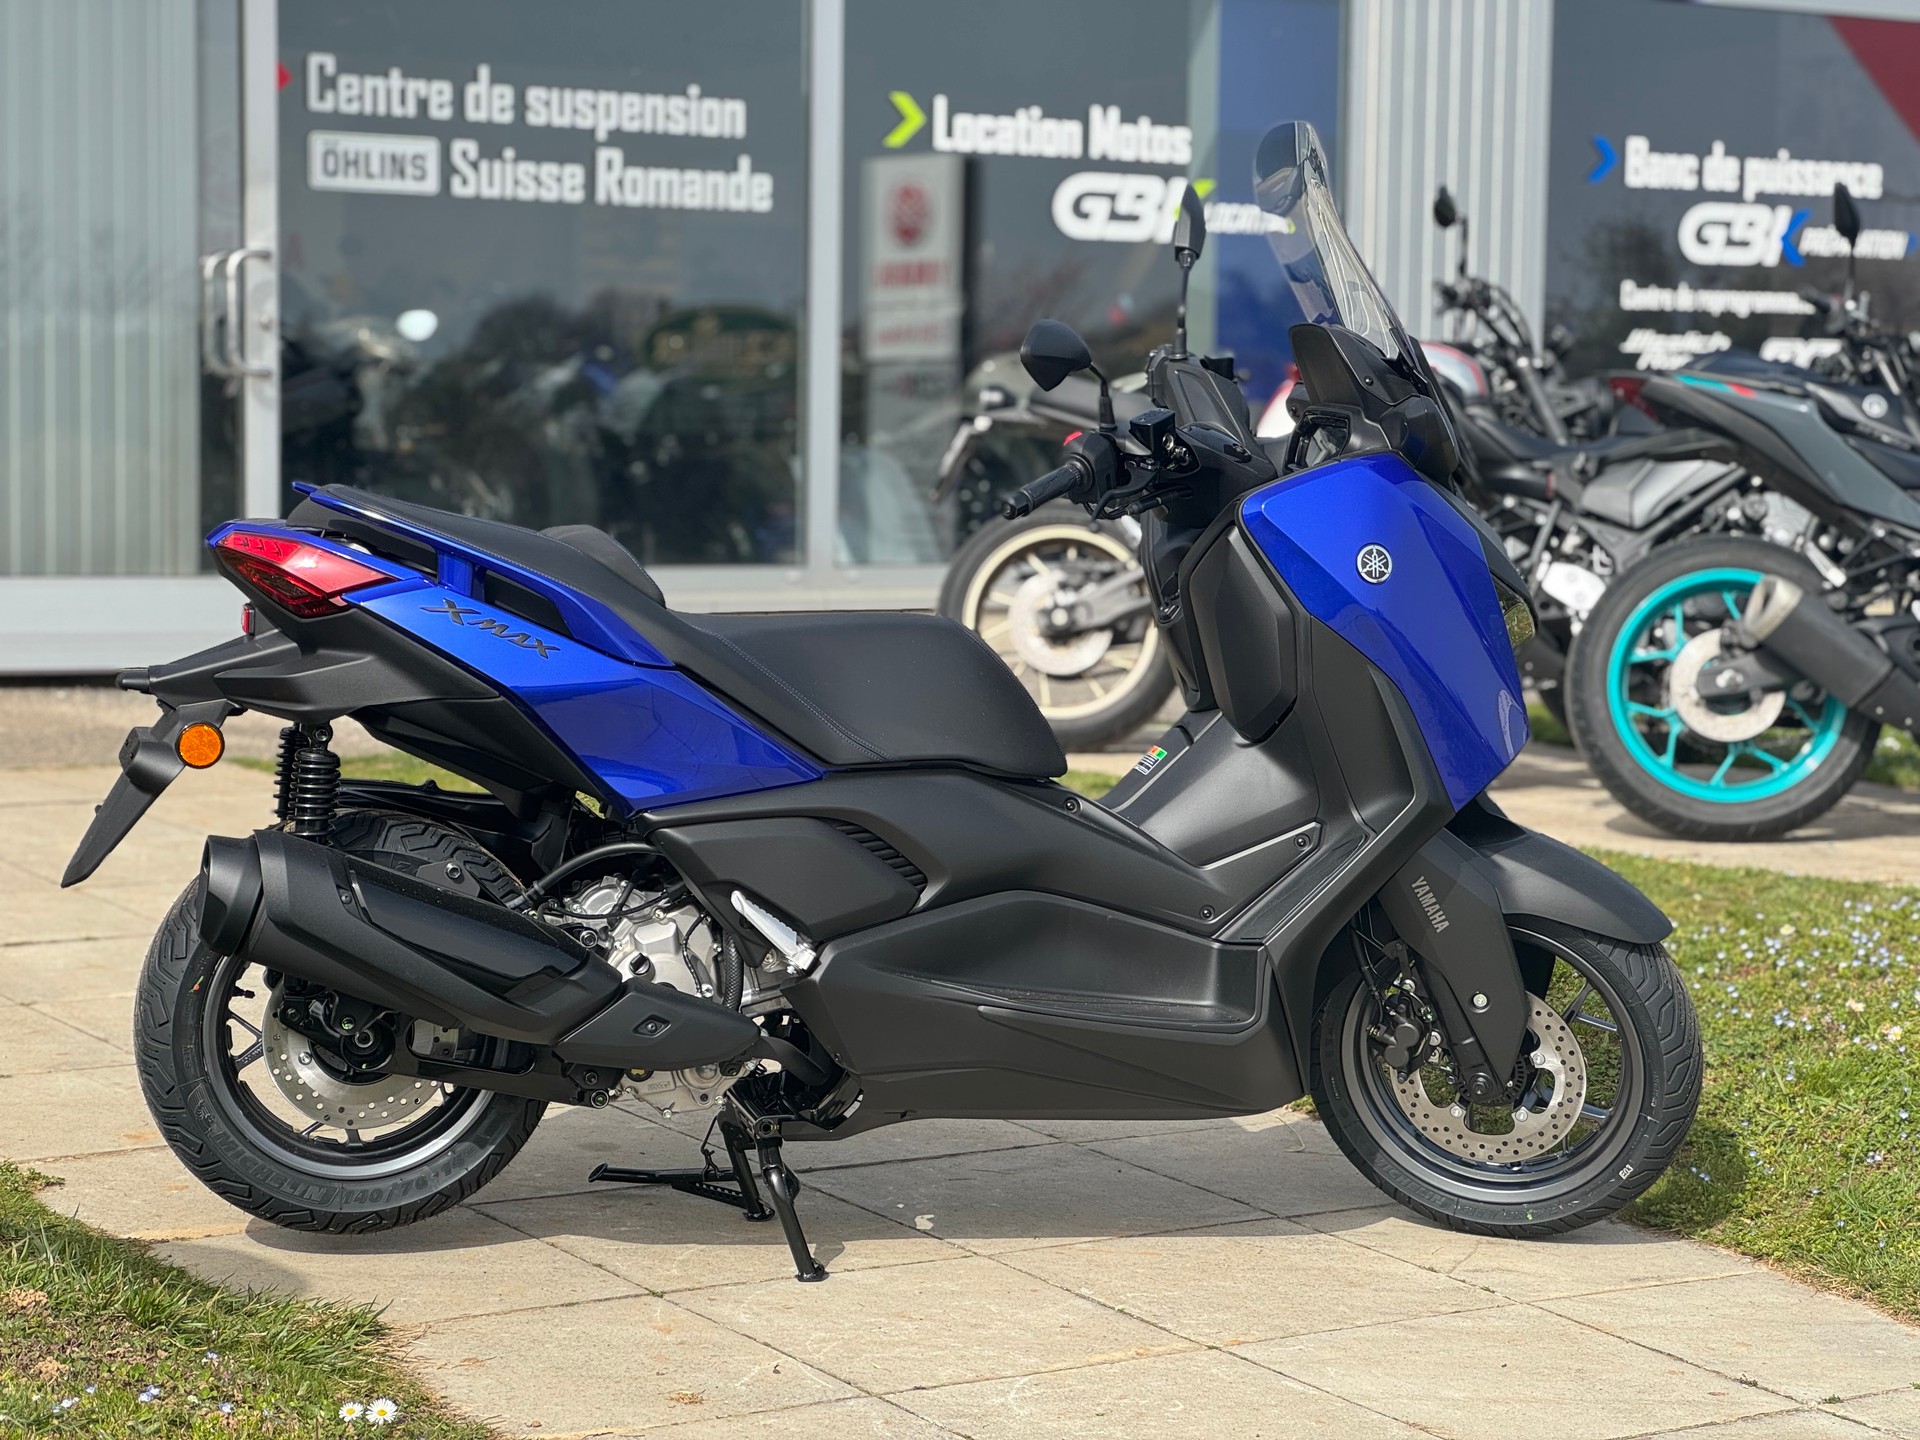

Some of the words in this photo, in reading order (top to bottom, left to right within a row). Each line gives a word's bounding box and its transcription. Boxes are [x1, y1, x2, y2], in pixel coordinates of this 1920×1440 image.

[306, 52, 453, 121] Centre
[464, 63, 515, 123] de
[525, 85, 747, 143] suspension
[932, 94, 1083, 159] Location
[1088, 104, 1192, 164] Motos
[321, 138, 428, 183] ÖHLINS
[450, 139, 585, 201] Suisse
[596, 147, 773, 212] Romande
[1624, 135, 1700, 191] Banc
[1411, 875, 1450, 933] YAMAHA
[212, 1130, 328, 1200] MICHELIN
